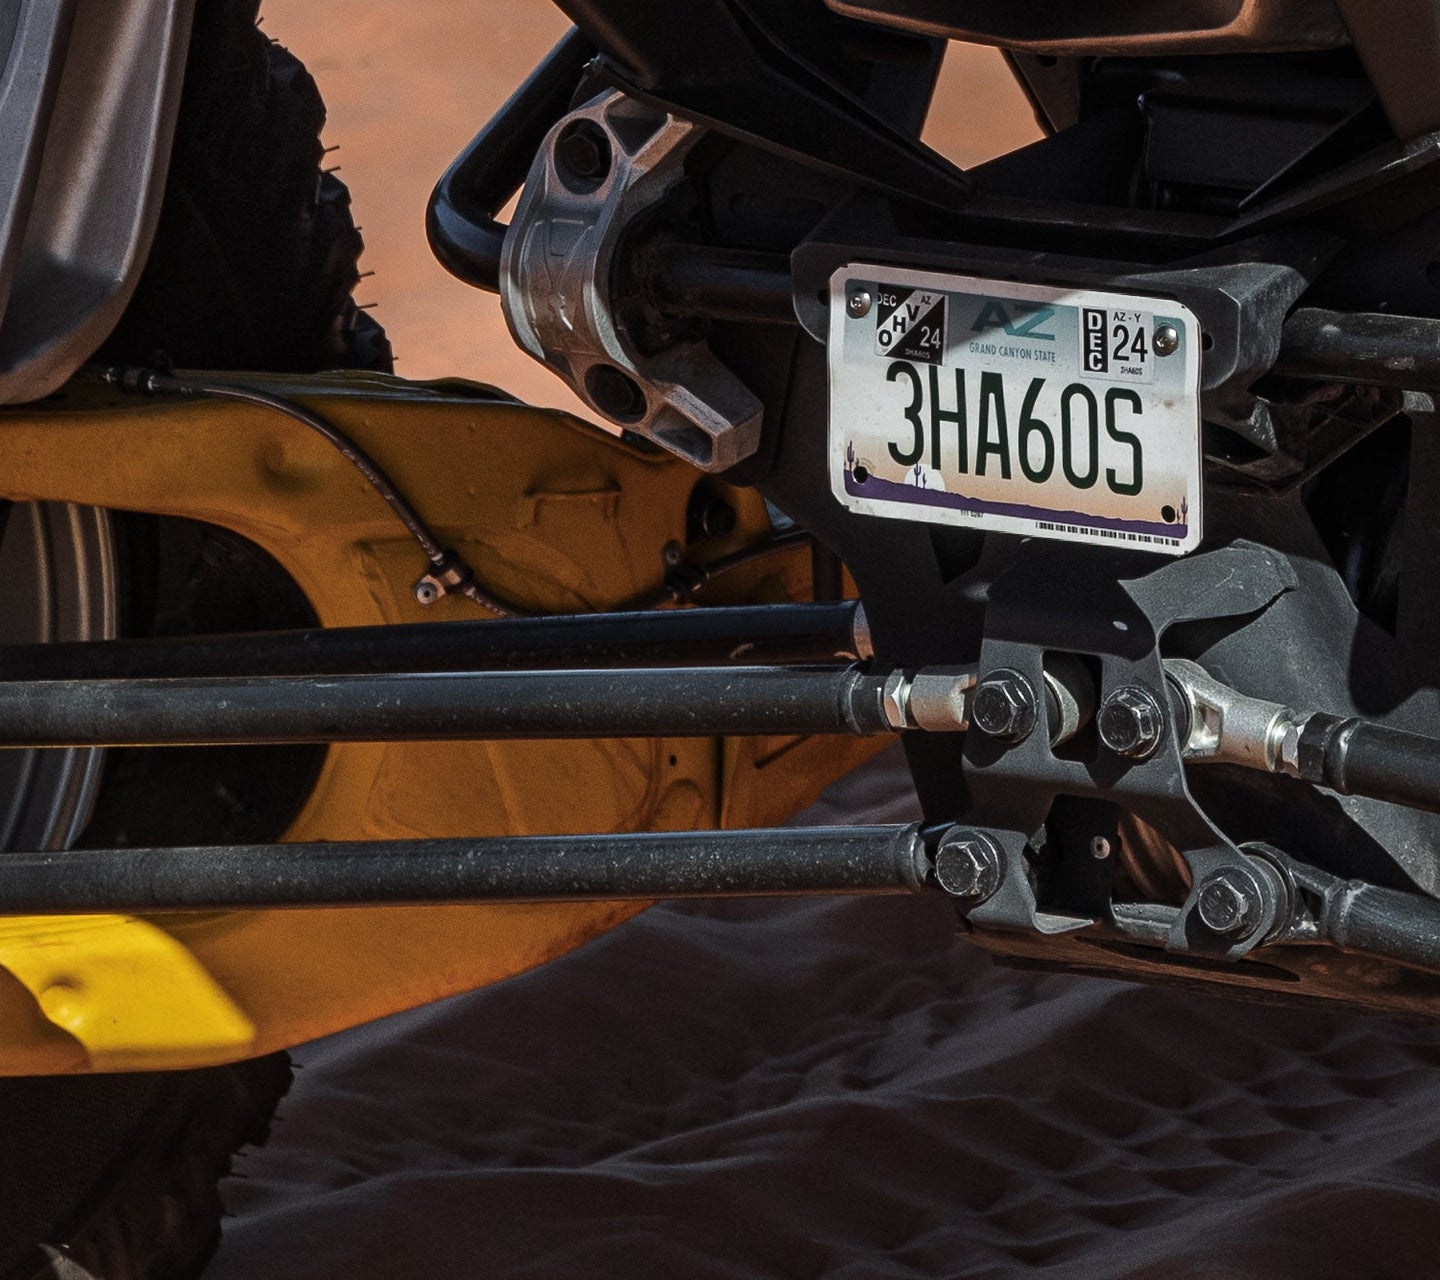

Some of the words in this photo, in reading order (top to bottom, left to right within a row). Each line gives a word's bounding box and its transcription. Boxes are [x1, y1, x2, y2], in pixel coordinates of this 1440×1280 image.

[920, 295, 932, 306] AZ
[920, 326, 941, 349] 24
[970, 300, 1056, 341] AZ
[969, 342, 997, 356] GRAND
[999, 345, 1033, 361] CANYON
[1033, 349, 1056, 363] STATE
[1087, 311, 1103, 371] DEC
[1112, 324, 1148, 363] 24
[886, 360, 1144, 497] 3HA60S
